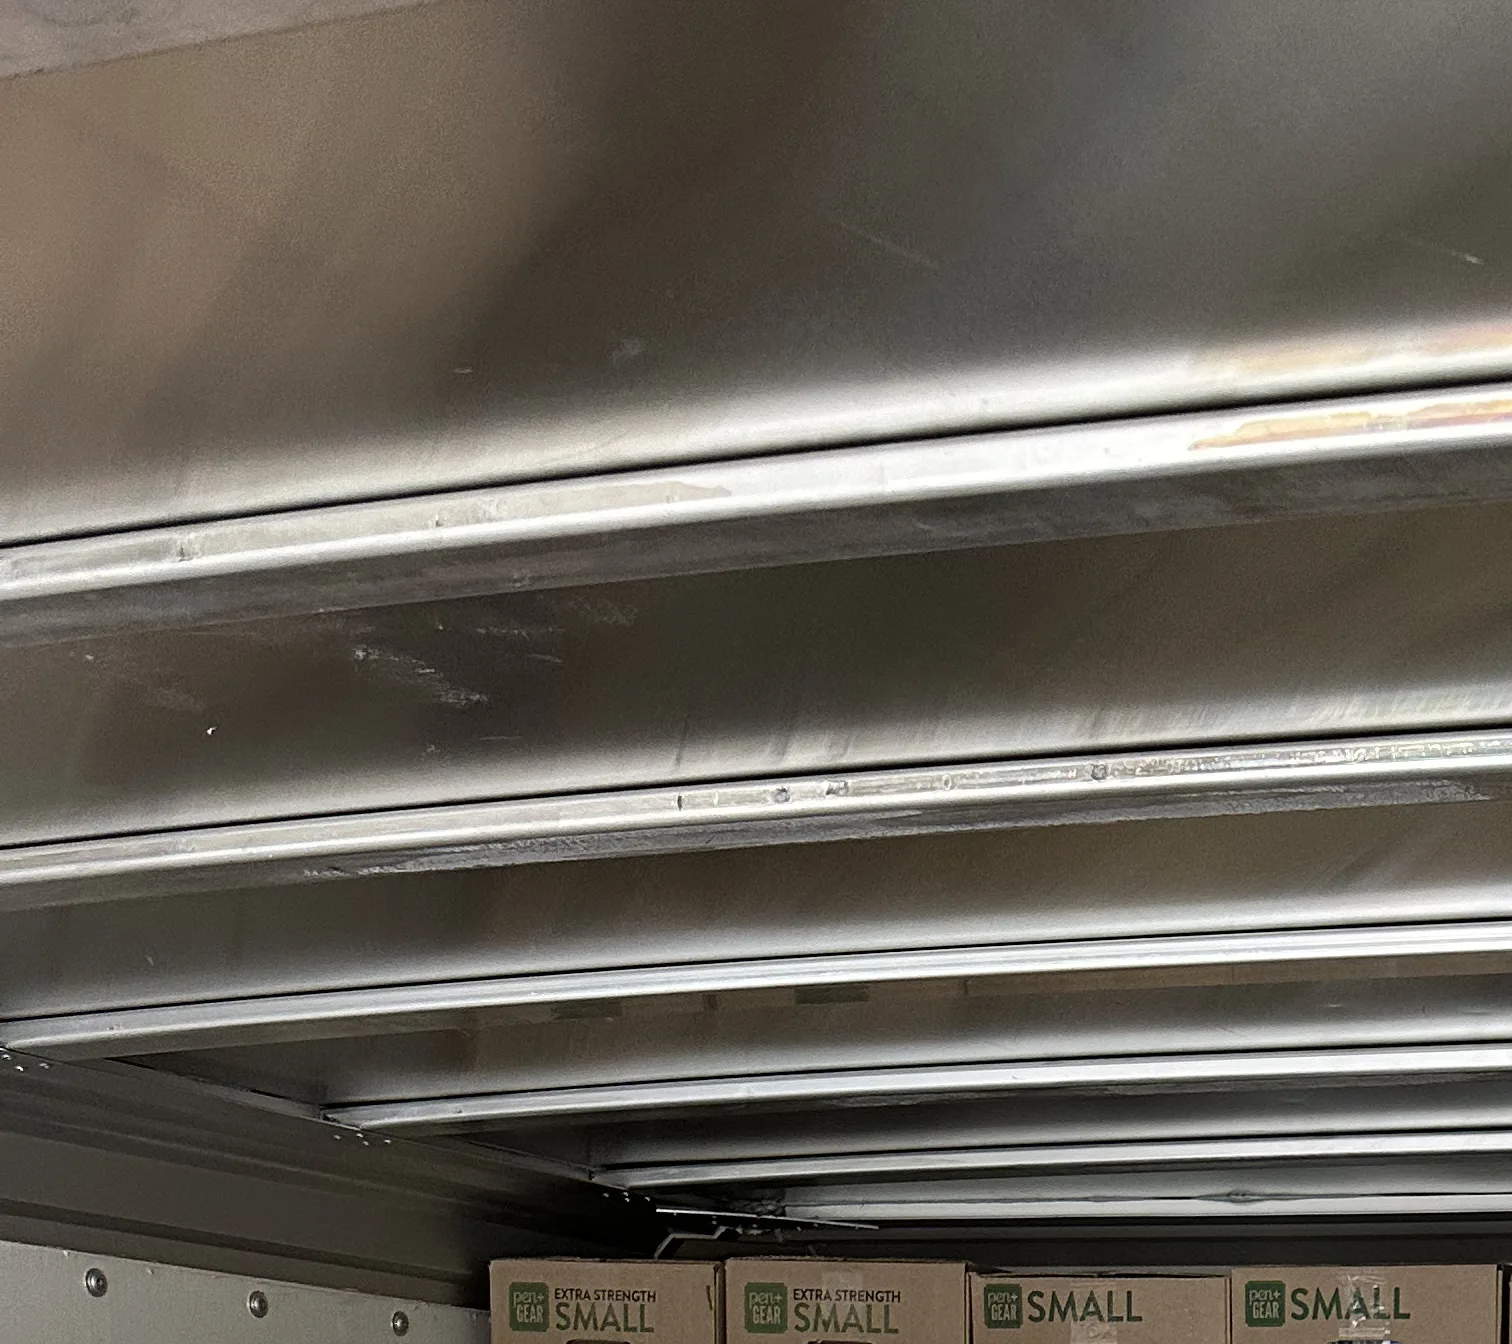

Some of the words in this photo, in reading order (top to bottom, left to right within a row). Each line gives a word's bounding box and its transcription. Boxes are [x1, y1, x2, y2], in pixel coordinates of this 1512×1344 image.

[554, 1288, 592, 1301] EXTRA
[594, 1288, 656, 1303] STRENGTH
[793, 1288, 832, 1302] EXTRA
[834, 1289, 900, 1303] STRENGTH
[1027, 1290, 1143, 1322] SMALL
[1291, 1287, 1411, 1320] SMALL
[556, 1303, 655, 1333] SMALL
[794, 1303, 899, 1334] SMALL
